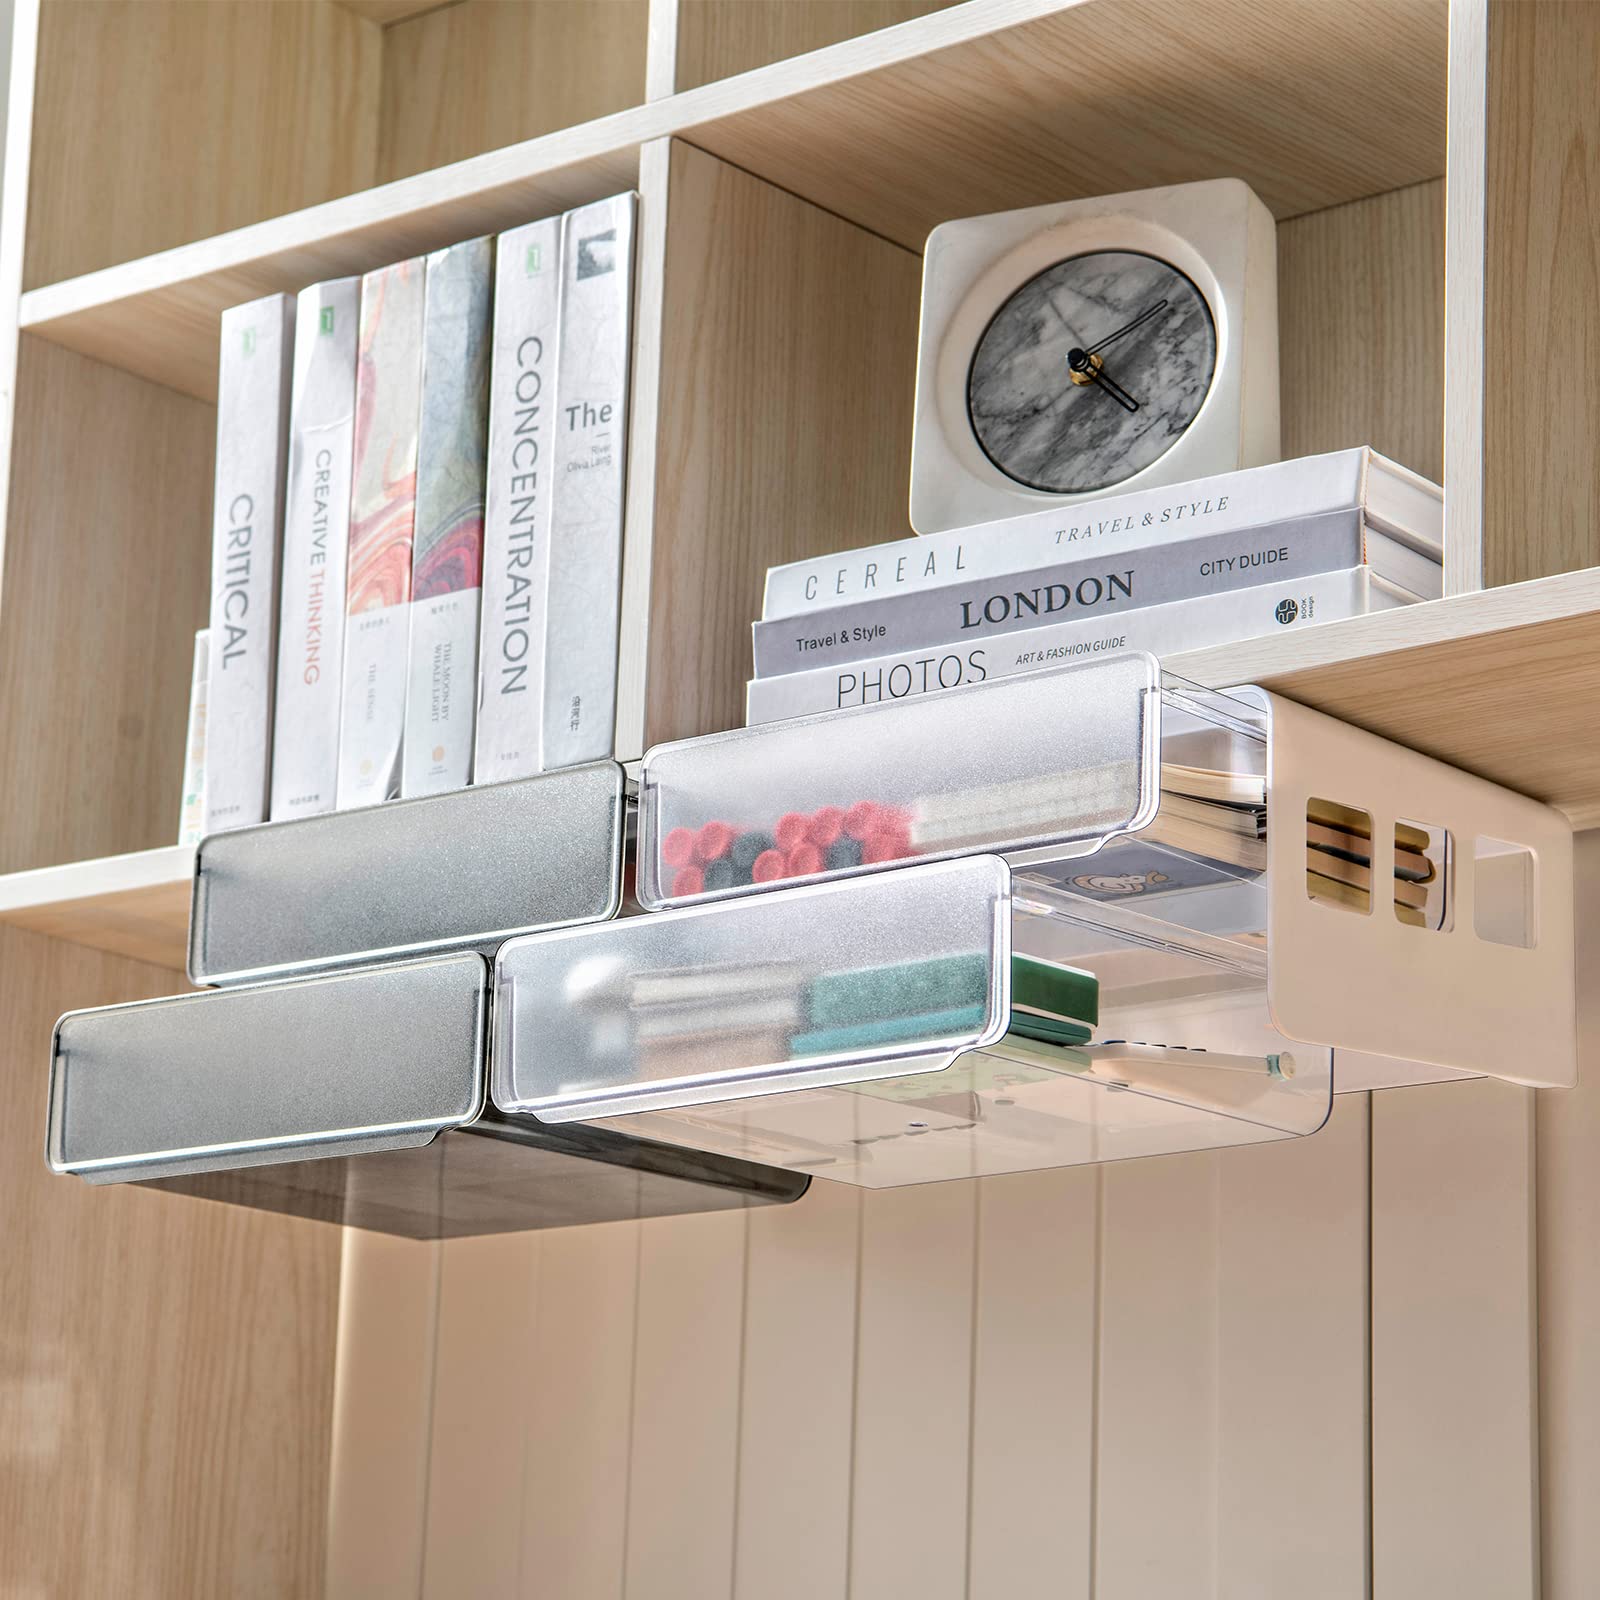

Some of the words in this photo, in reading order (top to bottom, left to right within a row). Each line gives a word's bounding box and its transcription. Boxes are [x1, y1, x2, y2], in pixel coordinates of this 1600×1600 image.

[565, 402, 612, 431] The
[310, 449, 331, 566] CREATIVE
[501, 336, 542, 695] CONCENTRATION
[1055, 516, 1134, 544] TRAVEL
[1141, 512, 1154, 527] &
[1160, 496, 1229, 523] STYLE
[222, 493, 254, 670] CRITICAL
[805, 545, 966, 600] CEREAL
[1200, 557, 1236, 576] CITY
[1239, 547, 1289, 569] DUIDE
[960, 570, 1135, 629] LONDON
[303, 570, 325, 686] THINKING
[796, 633, 837, 652] Travel
[840, 630, 850, 643] &
[853, 624, 887, 642] Style
[1016, 651, 1036, 665] ART
[1037, 650, 1044, 662] &
[1046, 642, 1091, 660] FASHION
[1092, 636, 1126, 652] GUIDE
[443, 641, 452, 665] THE
[442, 667, 452, 702] MOON
[837, 650, 987, 708] PHOTOS
[441, 704, 450, 721] BY
